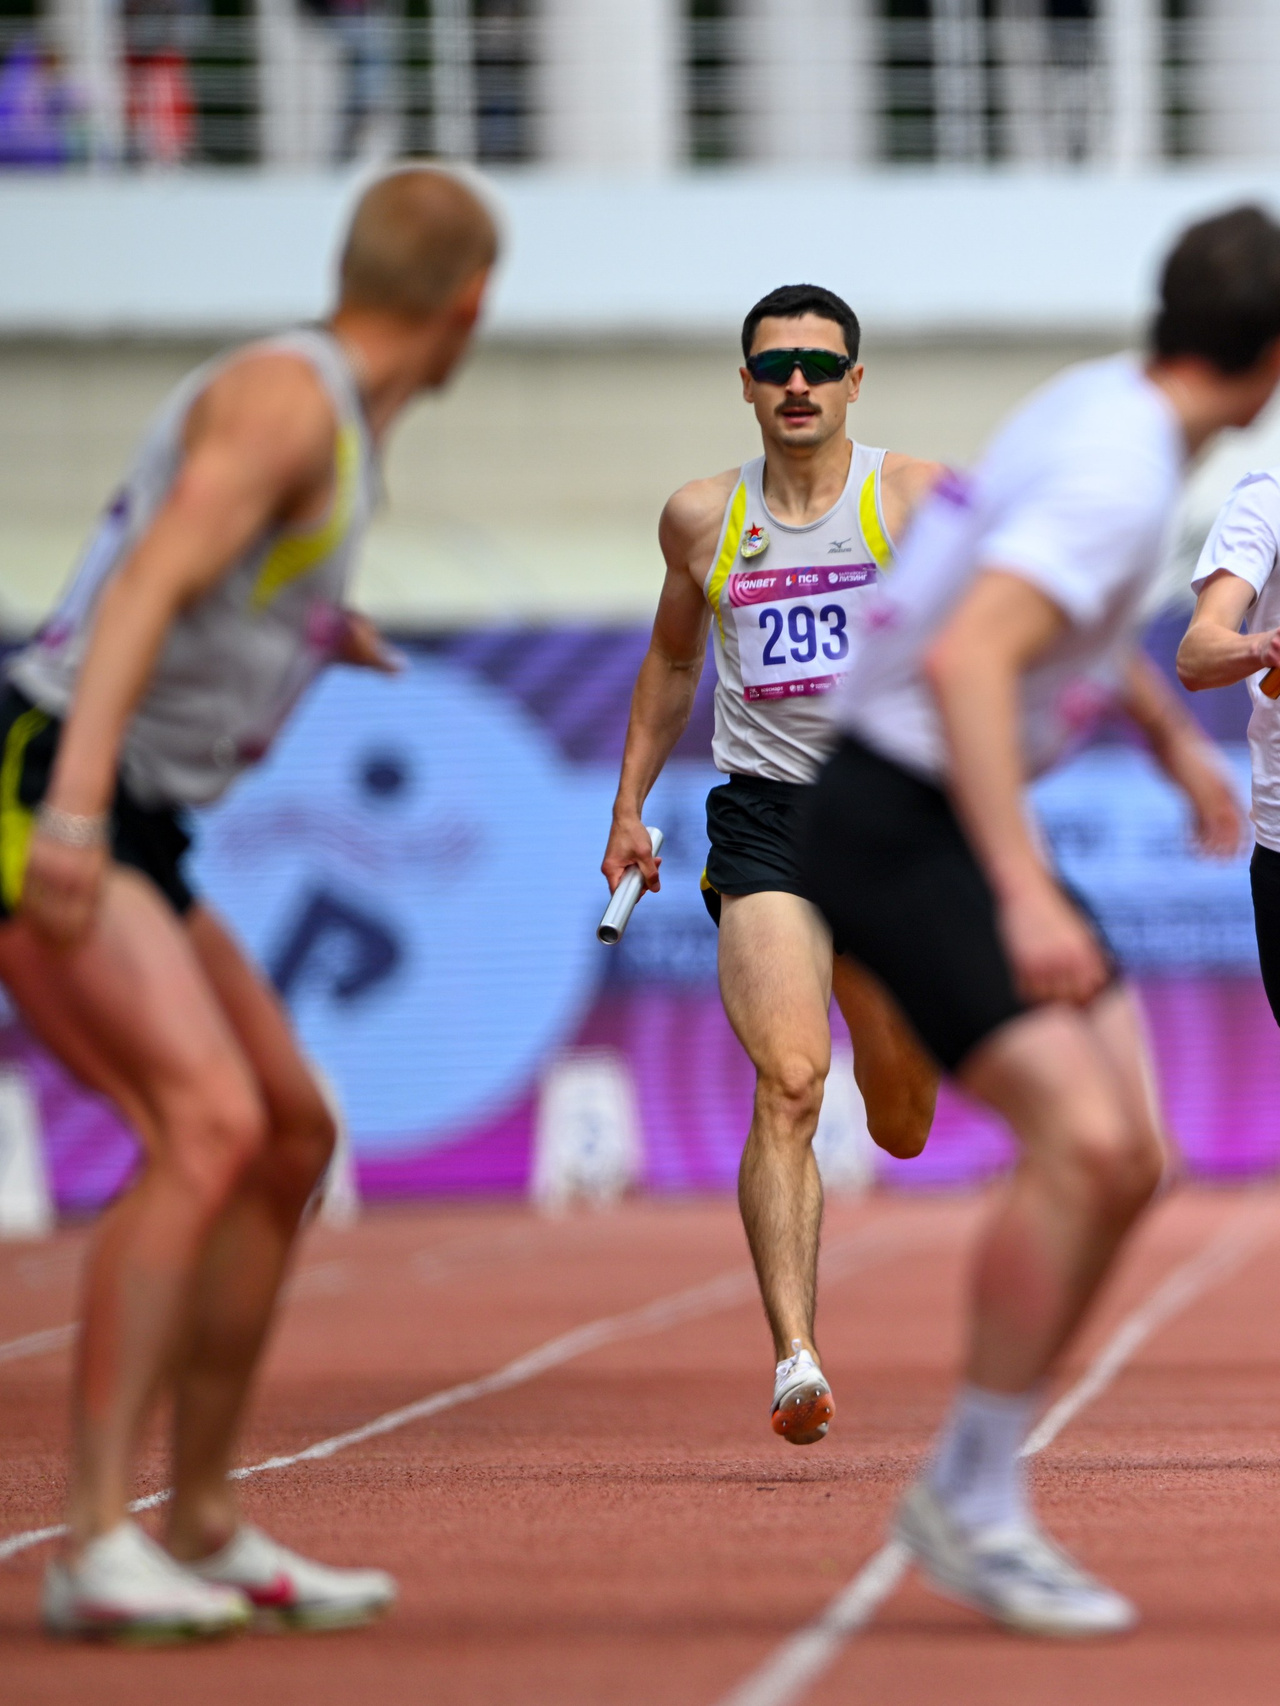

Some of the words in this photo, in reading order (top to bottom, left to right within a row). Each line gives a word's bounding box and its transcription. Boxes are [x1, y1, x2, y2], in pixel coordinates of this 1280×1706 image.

[737, 578, 777, 590] FONBET
[798, 574, 819, 584] ПСБ
[759, 604, 849, 666] 293
